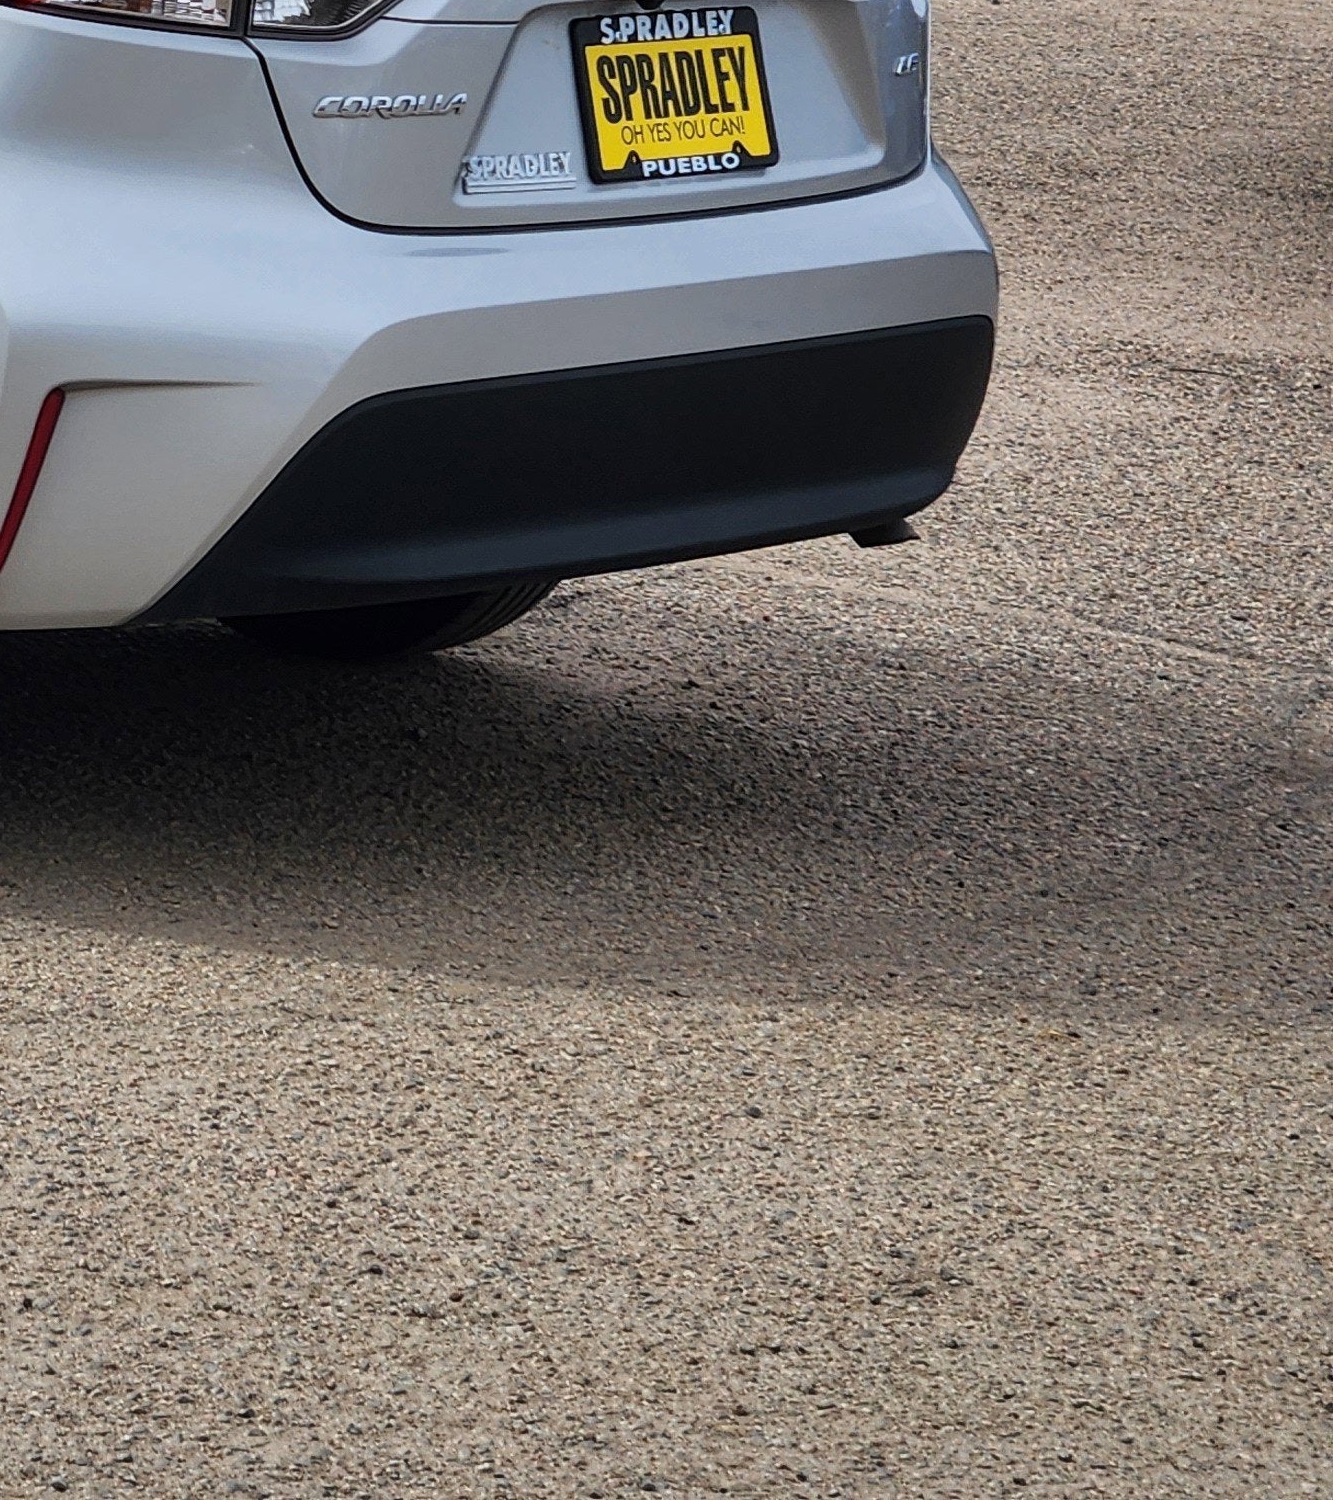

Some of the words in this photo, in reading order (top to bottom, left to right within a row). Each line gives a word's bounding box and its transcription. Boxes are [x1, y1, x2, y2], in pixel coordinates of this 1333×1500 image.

[600, 10, 735, 45] SPRADLEY
[596, 47, 750, 124] SPRADLEY
[313, 93, 468, 119] COROLLA
[621, 125, 645, 145] OH
[647, 122, 672, 143] YES
[673, 120, 706, 140] YOU
[710, 116, 746, 137] CAN!
[467, 152, 571, 180] SPRADLEY
[642, 152, 741, 177] PUEBLO
